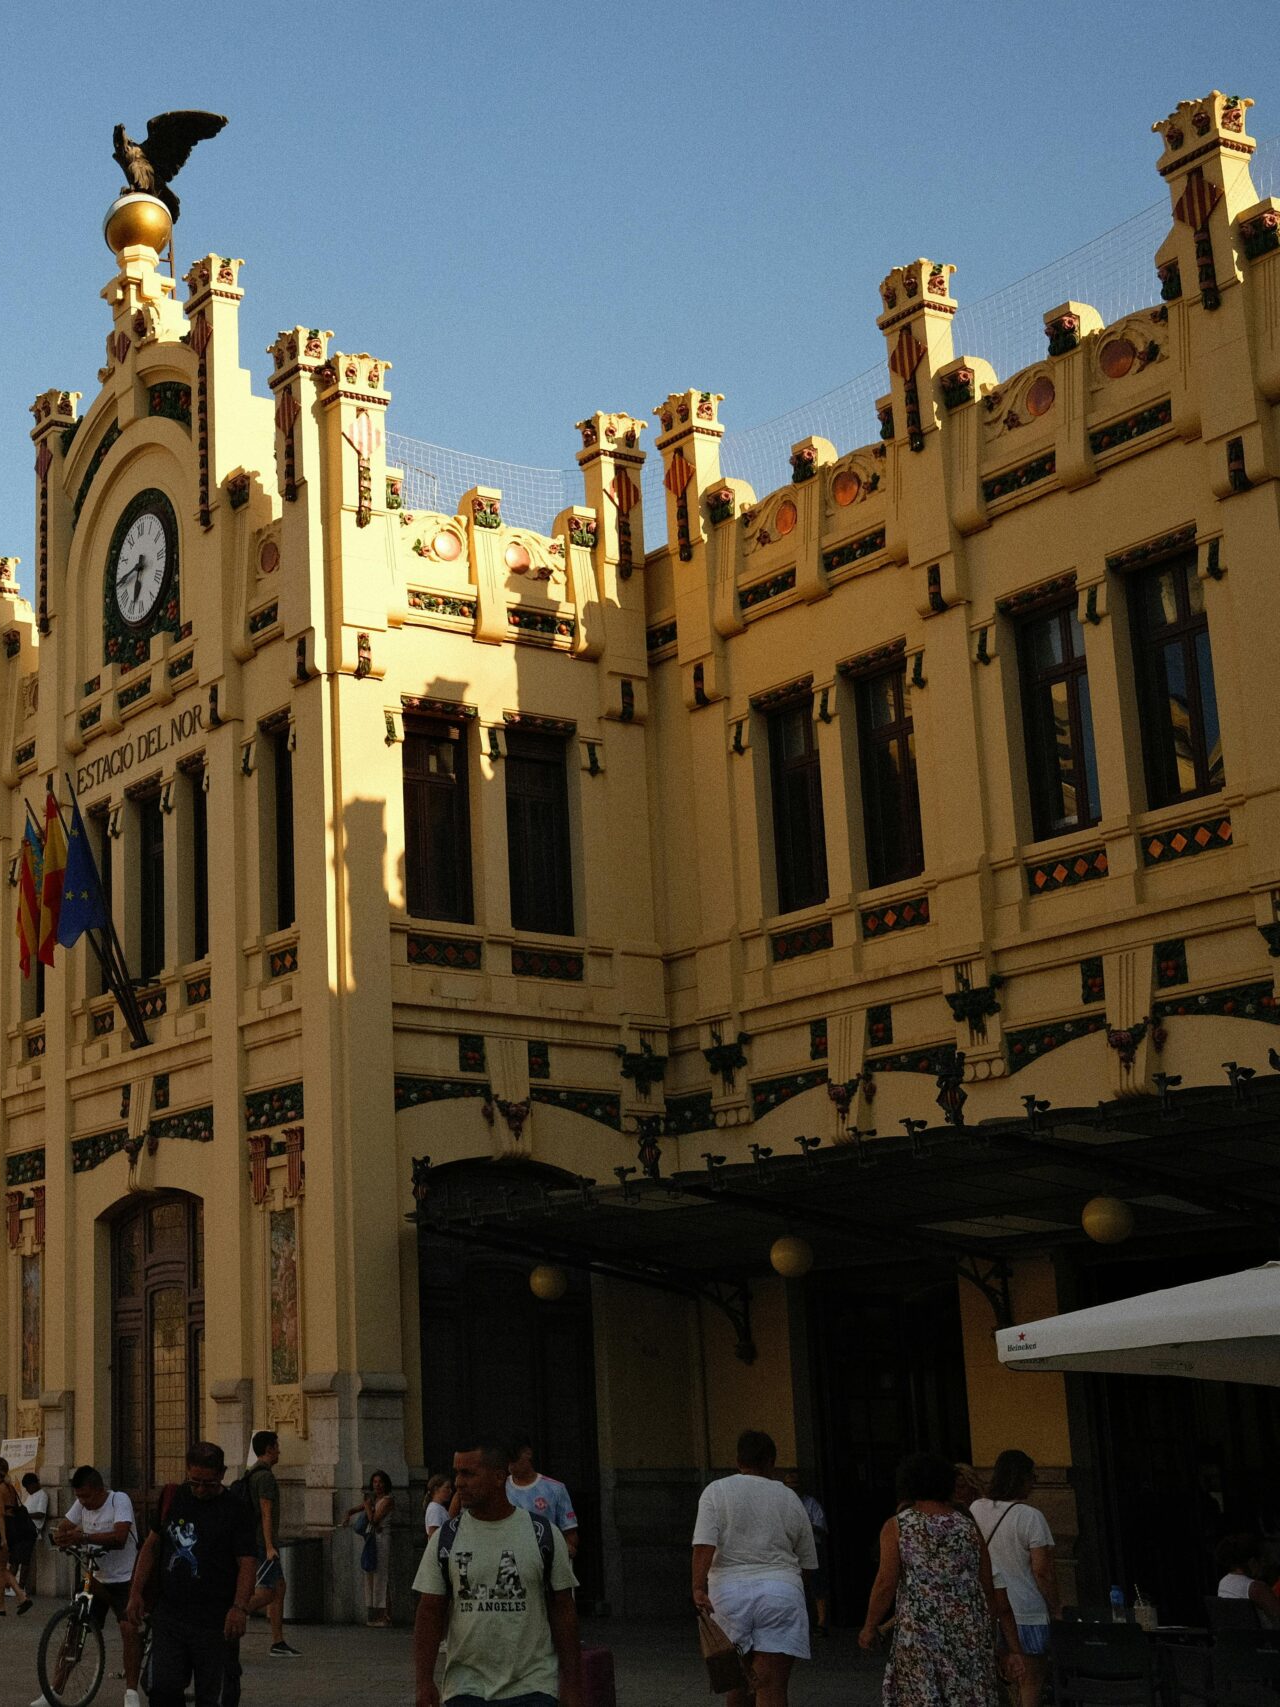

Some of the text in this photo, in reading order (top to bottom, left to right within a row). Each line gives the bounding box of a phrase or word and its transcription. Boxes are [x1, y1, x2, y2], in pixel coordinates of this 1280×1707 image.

[77, 733, 134, 796] ESTACIÓ
[137, 725, 168, 763] DEL
[1007, 1343, 1037, 1352] Heineken
[455, 1550, 526, 1600] LA
[460, 1601, 526, 1612] LOS ANGELES
